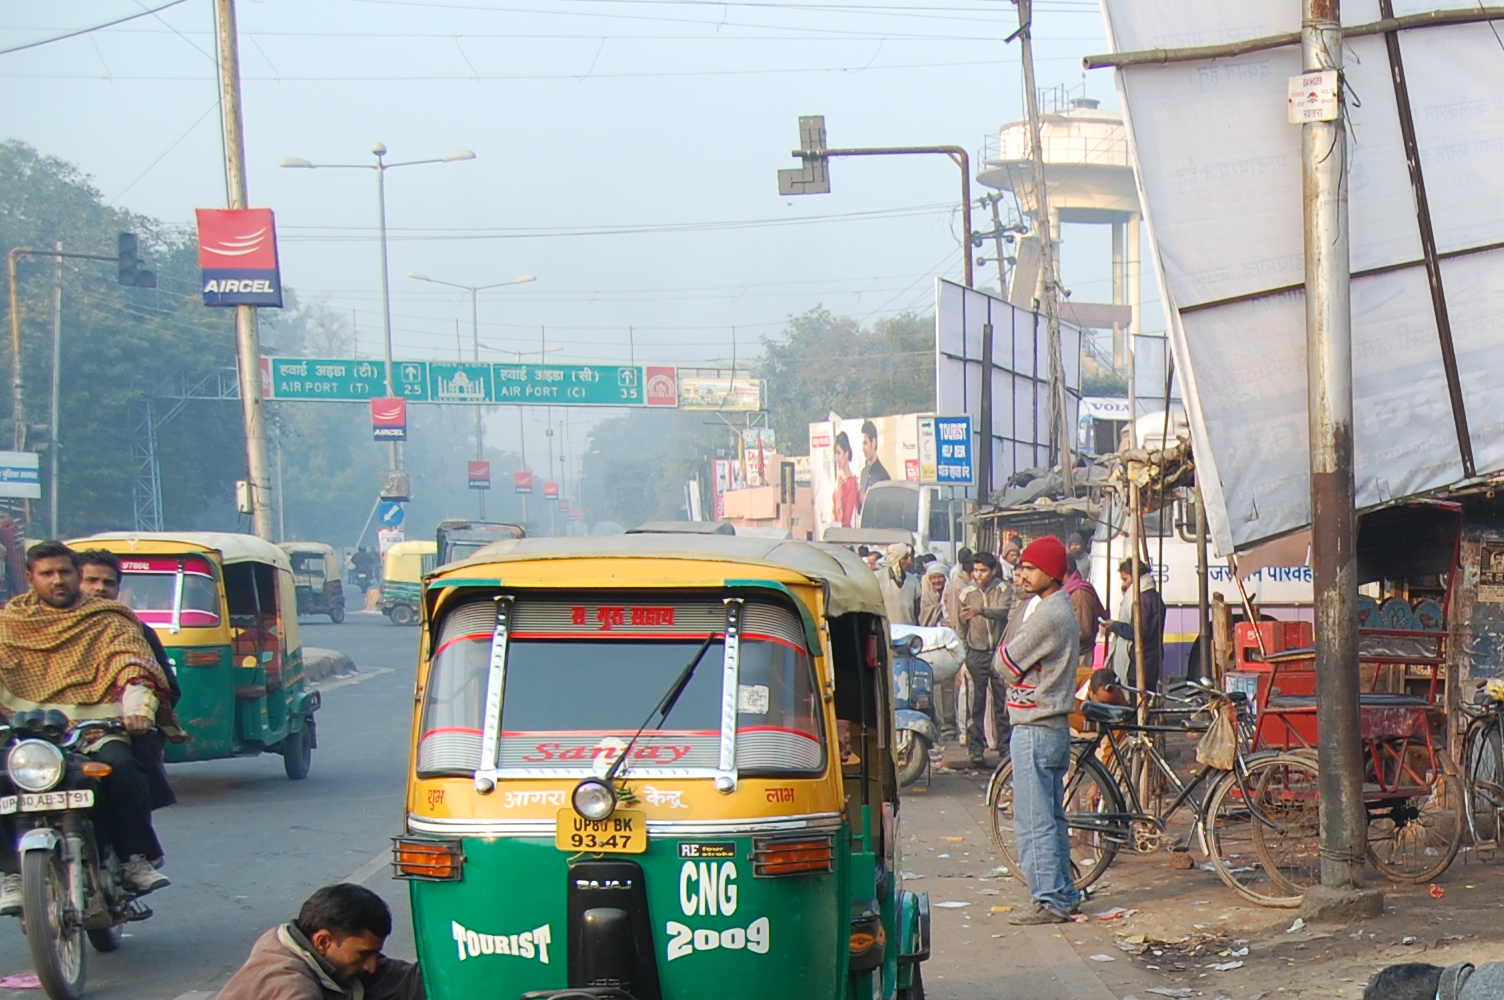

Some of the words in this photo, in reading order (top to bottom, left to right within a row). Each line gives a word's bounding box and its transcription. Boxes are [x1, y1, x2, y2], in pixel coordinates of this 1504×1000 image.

[204, 279, 275, 293] AIRCEL
[279, 362, 307, 377] हवाई
[501, 367, 528, 382] हवाई
[280, 382, 302, 392] AIR
[305, 383, 339, 393] PORT
[501, 386, 521, 396] AIR
[526, 386, 558, 397] PORT
[1091, 403, 1129, 412] VOLV
[374, 427, 404, 436] AIRCEL
[522, 740, 691, 766] Sanjay
[504, 790, 566, 808] आगरा
[766, 787, 795, 804] लाभ
[613, 818, 633, 832] BK
[681, 844, 699, 857] RE
[680, 860, 738, 916] CNG
[451, 920, 552, 965] TOURIST
[666, 916, 770, 962] 2009
